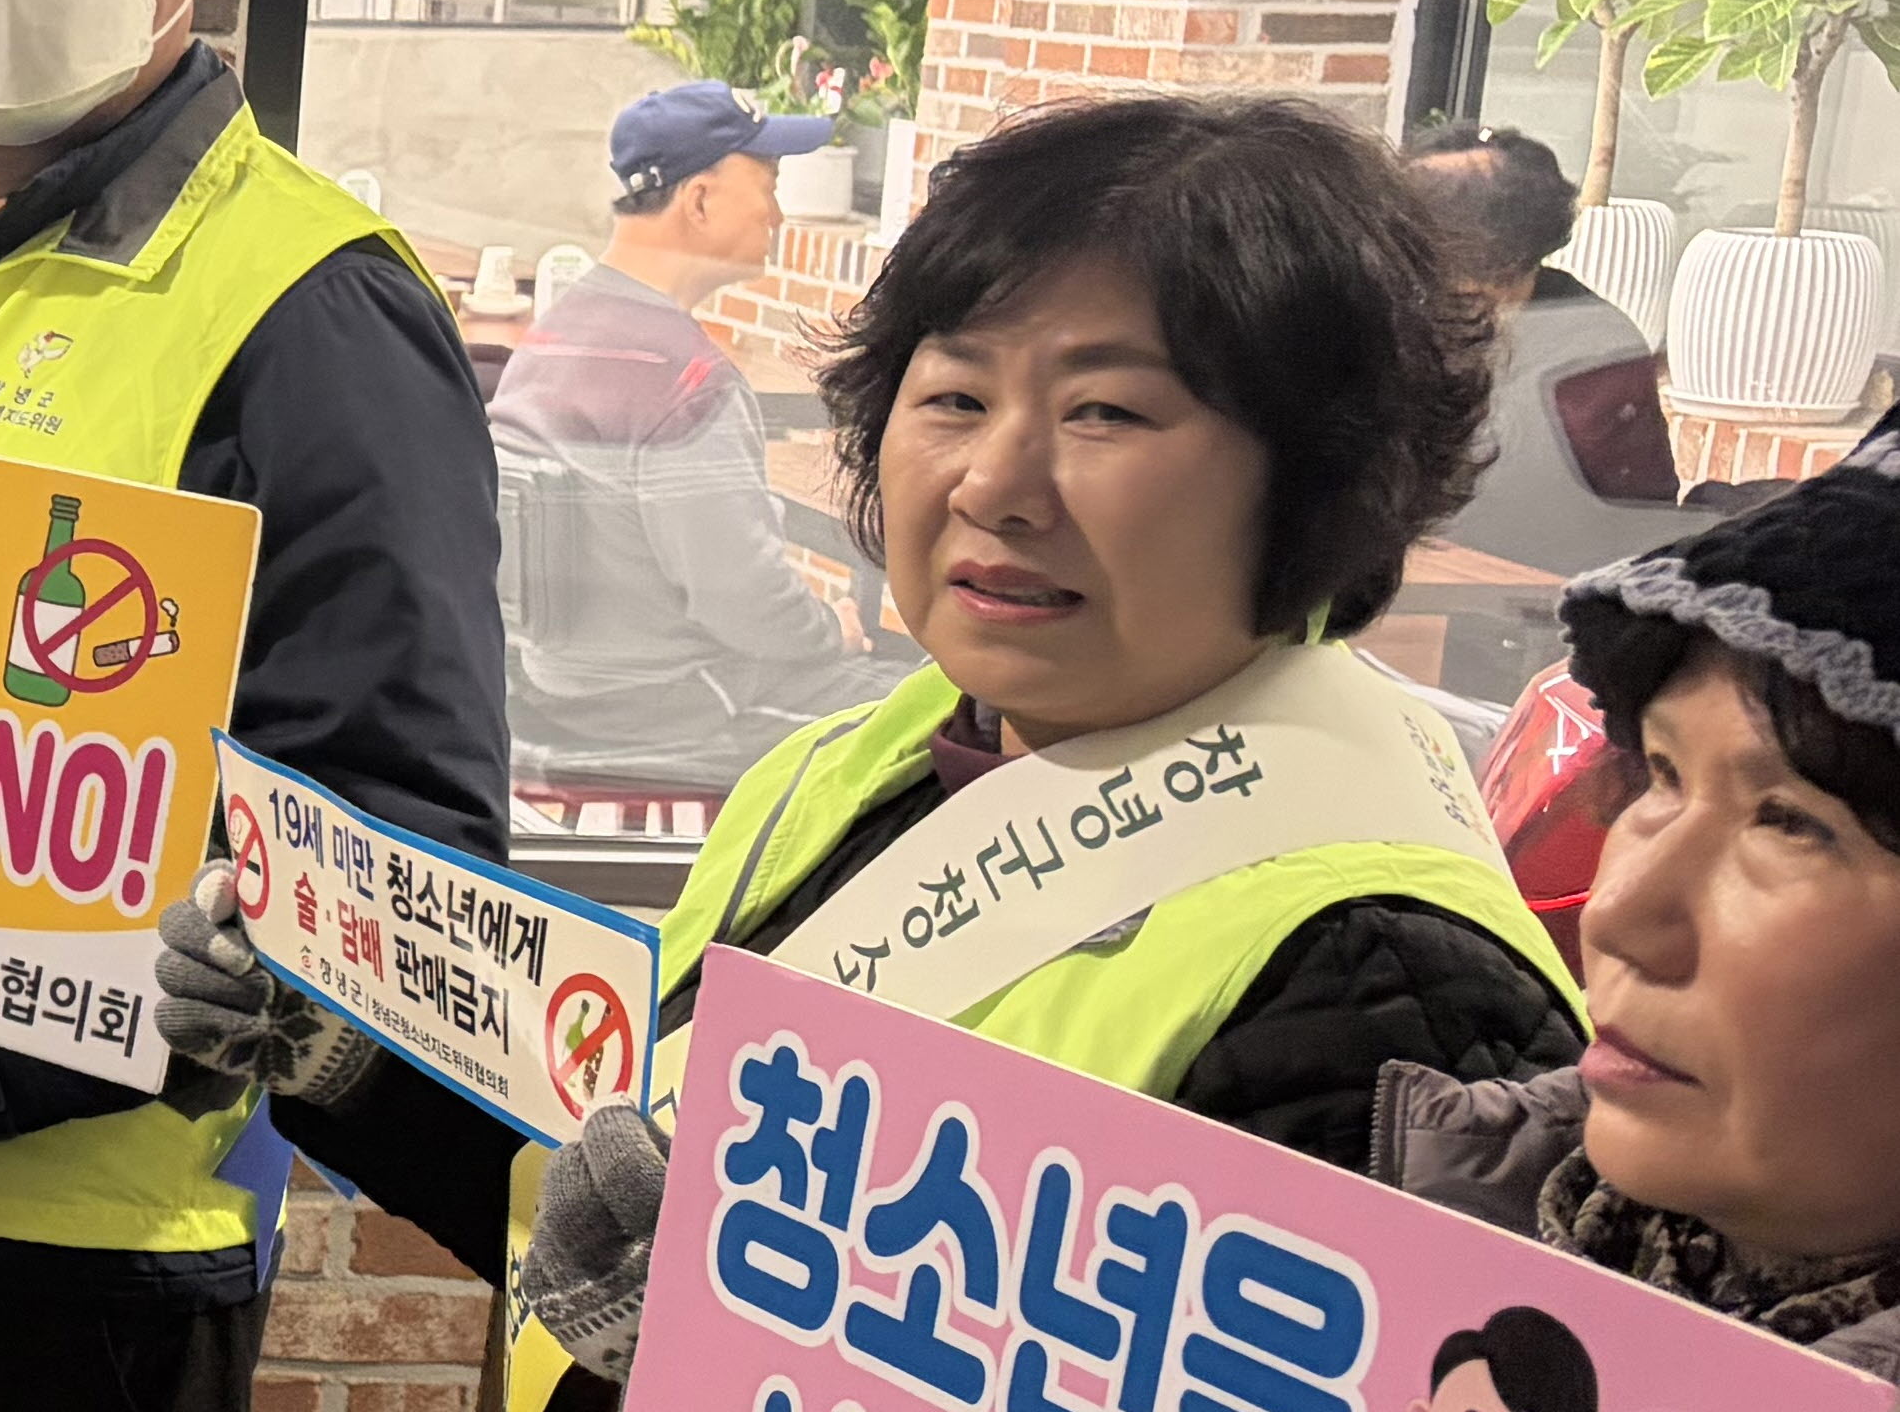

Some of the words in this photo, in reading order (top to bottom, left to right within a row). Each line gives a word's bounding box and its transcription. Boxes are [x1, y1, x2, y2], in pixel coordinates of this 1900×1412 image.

[269, 788, 324, 869] 19세
[333, 824, 375, 900] 미만
[387, 852, 548, 986] 청소년에게
[394, 934, 509, 1055] 판매금지
